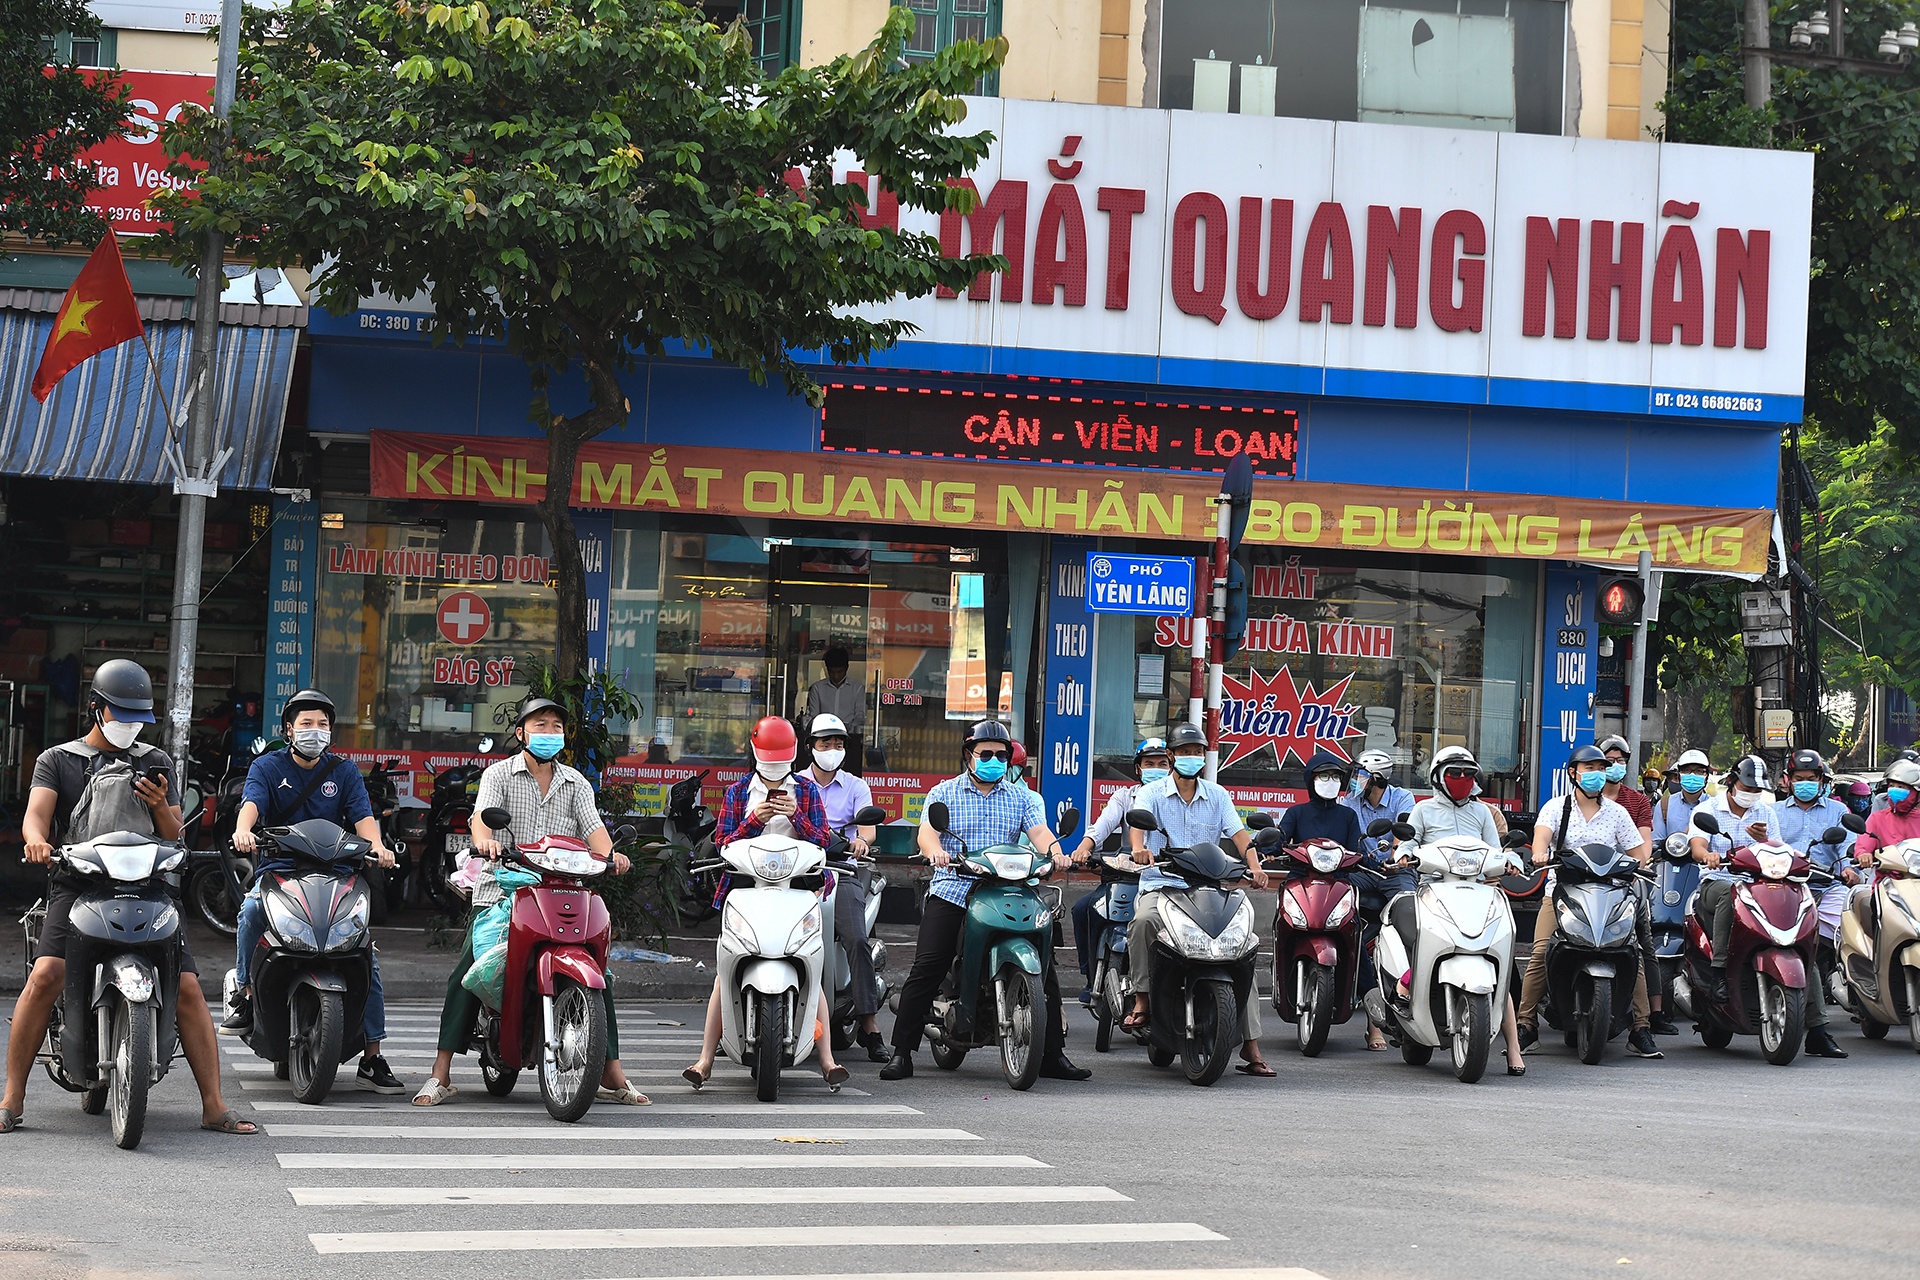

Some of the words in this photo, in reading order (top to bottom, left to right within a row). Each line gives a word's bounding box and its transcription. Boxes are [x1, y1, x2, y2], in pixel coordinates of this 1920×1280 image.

[185, 13, 197, 25] ĐT:
[199, 14, 216, 26] 0327
[937, 135, 1146, 310] MẮT
[1171, 191, 1487, 333] QUANG
[1522, 199, 1771, 350] NHÃN
[361, 314, 381, 329] ĐC:
[385, 315, 410, 331] 380
[1655, 393, 1674, 406] ĐT:
[1676, 394, 1699, 408] 024
[1702, 395, 1762, 412] 66862663
[964, 409, 1040, 452] CẬN
[1194, 427, 1292, 466] LOẠN
[580, 447, 723, 510] MẮT
[743, 470, 975, 524] QUANG
[997, 479, 1184, 536] NHÃN
[1340, 499, 1559, 558] ĐƯỜNG
[1578, 512, 1744, 568] LÁNG
[284, 533, 304, 551] BẢO
[578, 532, 602, 573] HỮA
[329, 543, 377, 575] LÀM
[382, 546, 436, 578] KÍNH
[441, 553, 498, 581] THEO
[502, 553, 550, 583] ĐƠN
[1130, 561, 1163, 576] PHỐ
[281, 576, 302, 592] BẢO
[1253, 555, 1319, 600] MẮT
[1095, 579, 1132, 604] YÊN
[1137, 579, 1187, 607] LÃNG
[274, 598, 308, 614] DƯỠNG
[1565, 580, 1583, 627] SỞ
[280, 619, 300, 634] SỬA
[1238, 613, 1310, 655] HỮA
[1317, 616, 1394, 659] KÍNH
[276, 641, 302, 655] CHỮA
[1056, 623, 1087, 657] THEO
[1559, 631, 1585, 646] 380
[276, 662, 300, 675] THAY
[434, 654, 479, 686] BÁC
[484, 656, 516, 687] SỸ
[1556, 652, 1587, 690] DỊCH
[887, 678, 913, 690] OPEN
[882, 693, 894, 705] 8h
[903, 693, 922, 706] 21h
[1057, 677, 1084, 717] ĐƠN
[1219, 694, 1291, 737] Miễn
[1295, 703, 1352, 739] Phí
[1560, 710, 1578, 749] VỤ
[430, 756, 458, 767] QUANG
[1054, 735, 1080, 776] BÁC
[637, 768, 662, 779] NHAN
[862, 777, 886, 787] NHAN
[887, 778, 921, 788] OPTICAL
[1237, 791, 1260, 802] NHAN
[1262, 792, 1295, 804] OPTICAL
